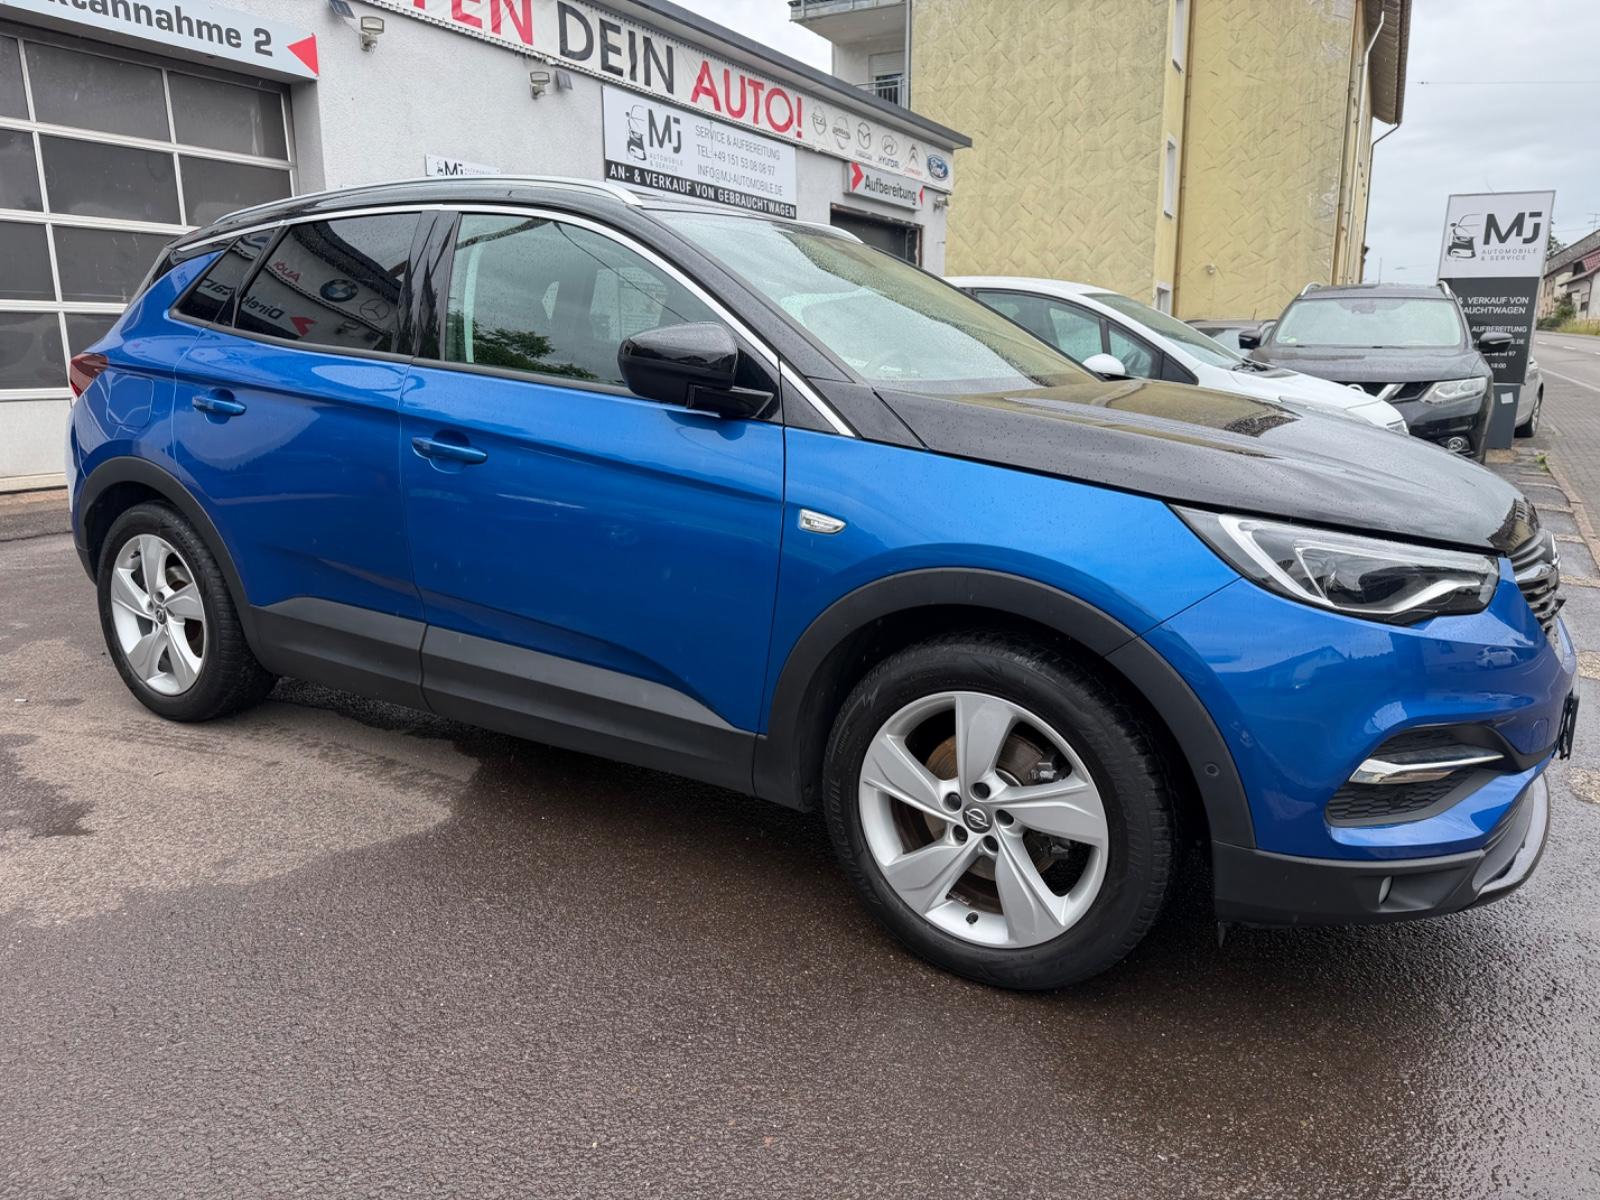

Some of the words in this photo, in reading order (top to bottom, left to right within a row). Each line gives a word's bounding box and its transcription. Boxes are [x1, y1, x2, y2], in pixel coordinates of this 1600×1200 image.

[254, 27, 273, 56] 2
[558, 1, 674, 95] DEIN
[690, 60, 803, 139] AUTO!
[696, 124, 725, 145] SERVICE
[733, 136, 780, 160] AUFBEREITUNG
[610, 163, 630, 179] AN-
[634, 169, 642, 182] &
[645, 171, 692, 195] VERKAUF
[695, 183, 715, 199] VON
[717, 189, 796, 217] GEBRAUCHTWAGEN
[864, 174, 917, 206] Aufbereitung
[1482, 247, 1538, 255] AUTOMOBILE
[1463, 306, 1526, 314] AUCHTWAGEN
[1468, 296, 1508, 304] VERKAUF
[1510, 296, 1530, 304] VON
